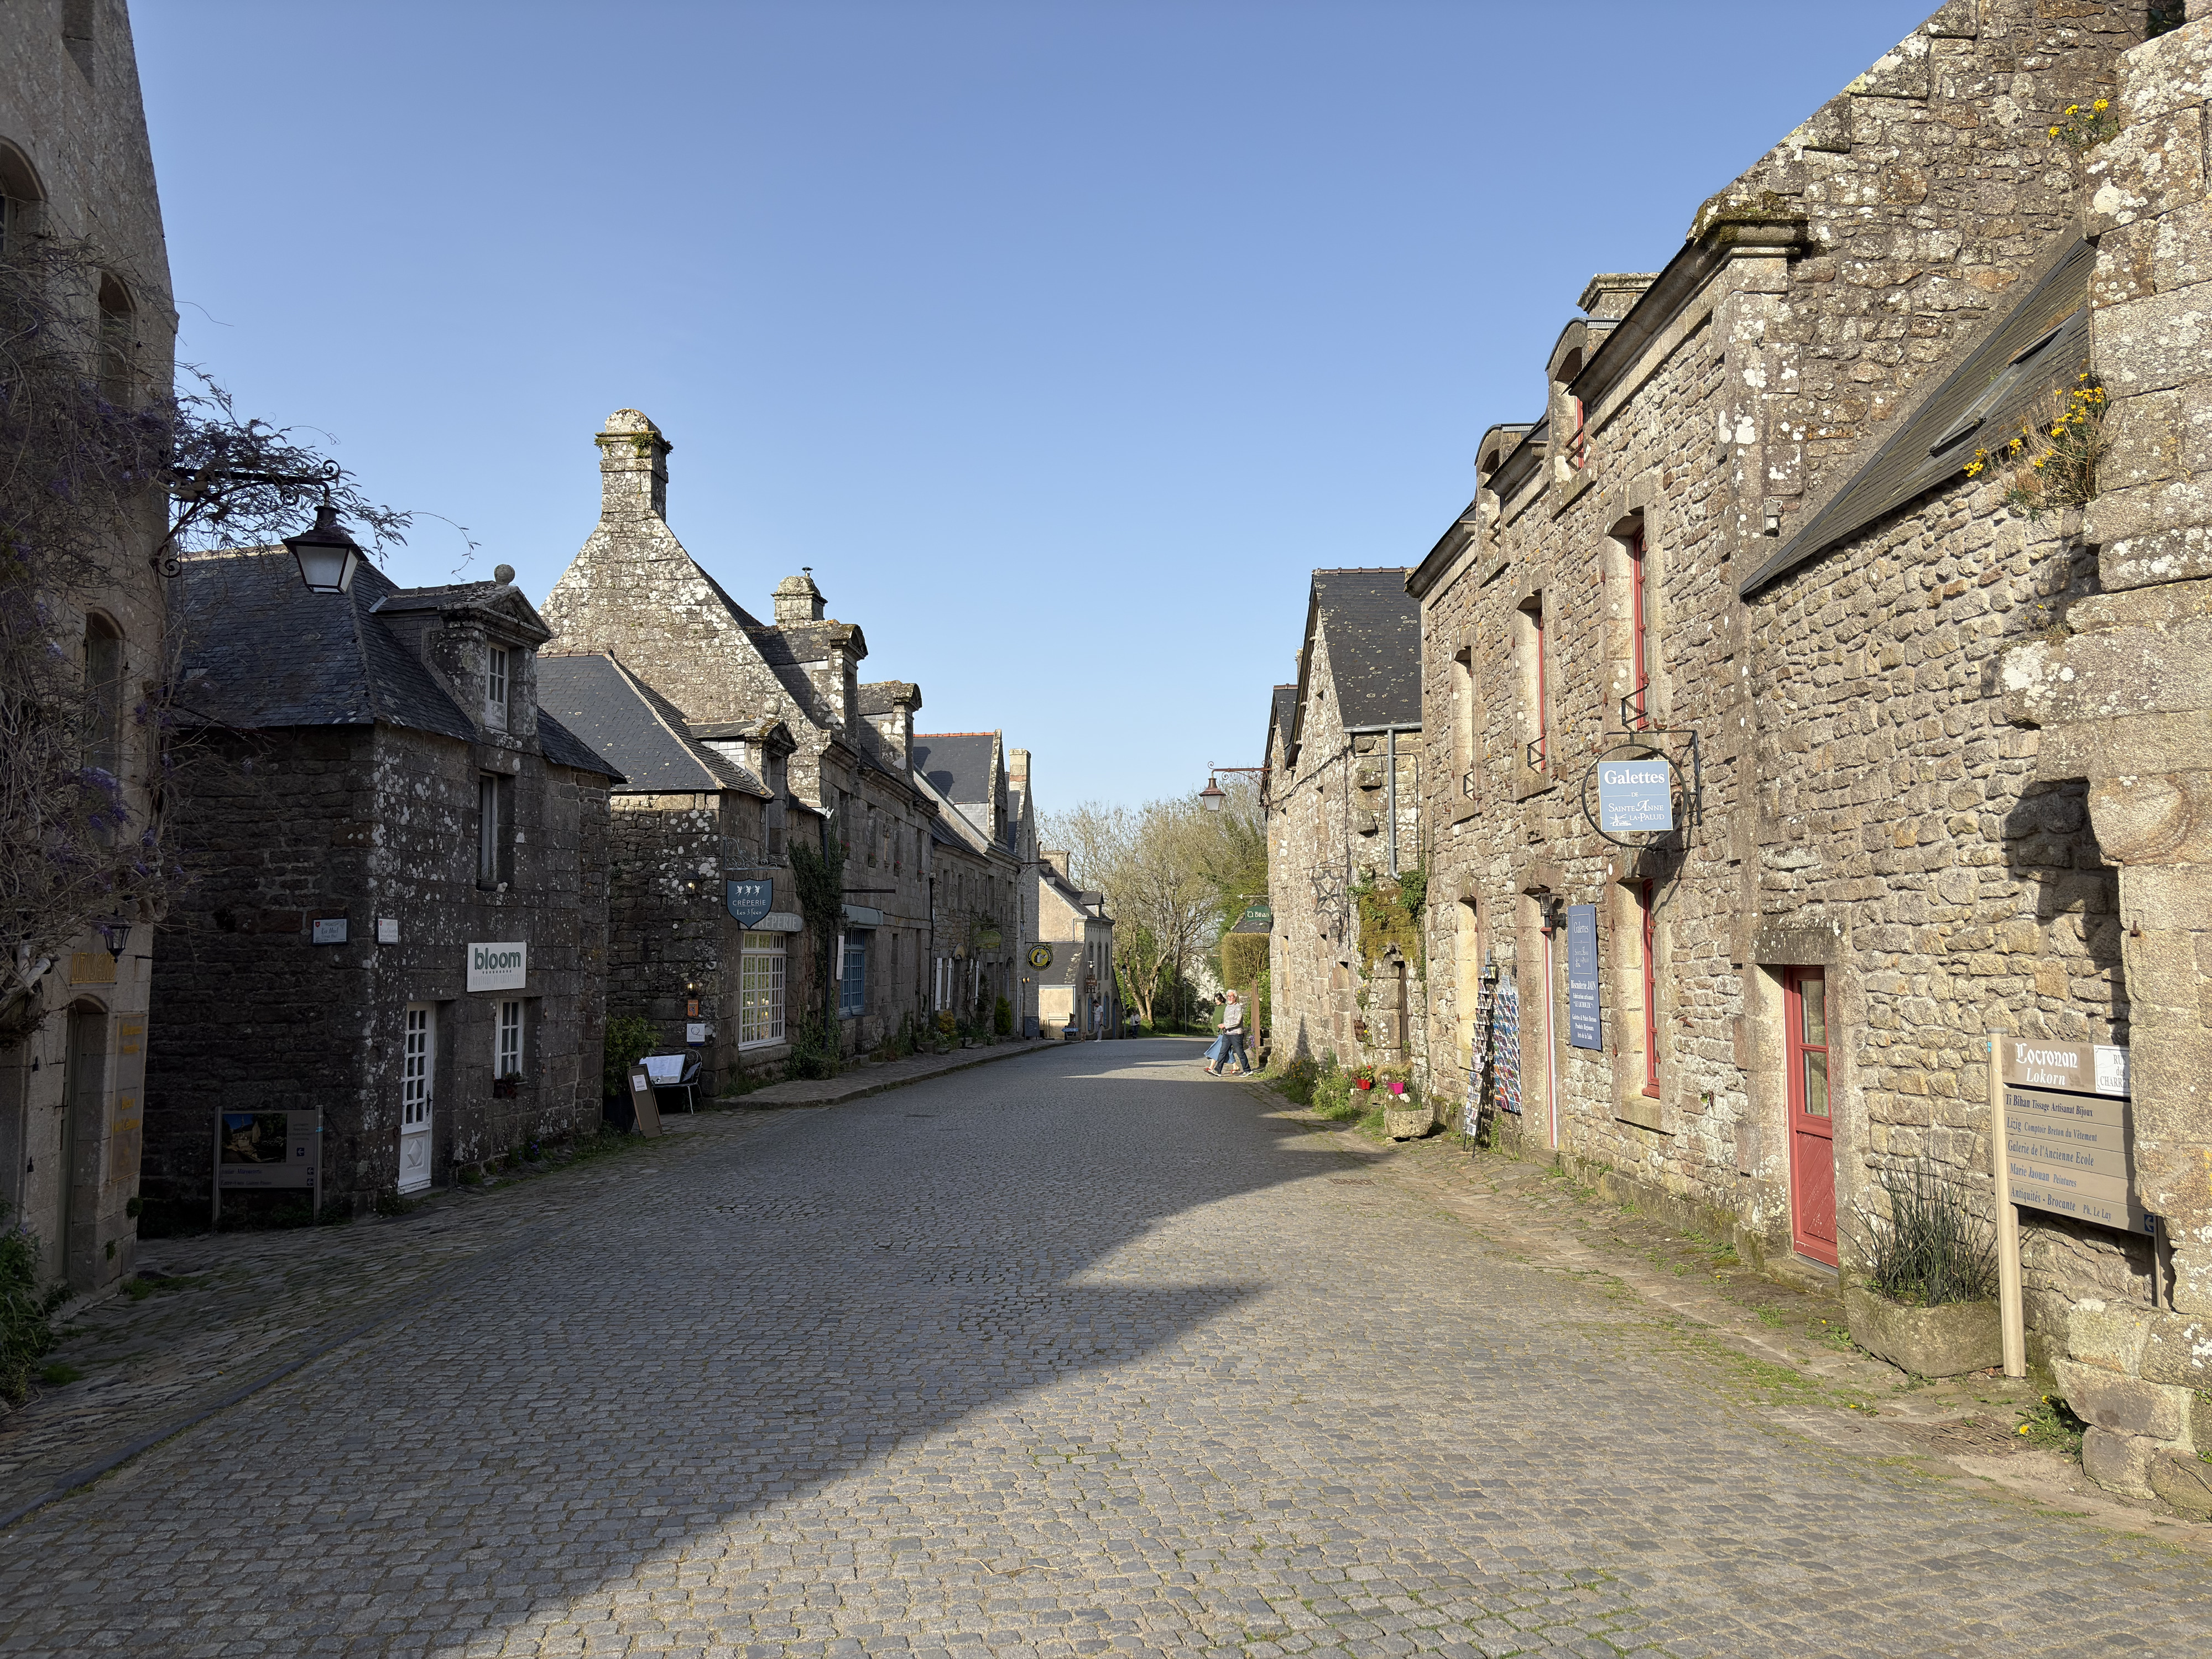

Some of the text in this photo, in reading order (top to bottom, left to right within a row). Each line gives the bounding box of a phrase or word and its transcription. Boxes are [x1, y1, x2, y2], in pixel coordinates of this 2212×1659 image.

[1604, 769, 1665, 785] Galettes
[1573, 921, 1589, 933] Galettes
[474, 947, 521, 970] bloom
[1571, 979, 1587, 990] Biscuiterie
[2015, 1042, 2077, 1068] Locronan
[2113, 1055, 2127, 1065] RUE
[2026, 1067, 2065, 1086] Lokorn
[2116, 1067, 2125, 1077] des
[2006, 1094, 2093, 1118] Ti Bihan Tissage Artisanat Bijoux
[2007, 1117, 2097, 1142] Lizig Comptoir Breton du Vêtement
[2008, 1140, 2094, 1166] Galerie de l'Ancienne Ecole
[2010, 1162, 2077, 1187] Marie Jaouan Peintures
[2011, 1186, 2041, 1203] Antiquités
[2047, 1193, 2075, 1211] Brocante
[2083, 1204, 2091, 1215] Ph.
[2094, 1207, 2100, 1217] Le
[2102, 1208, 2111, 1222] Lay
